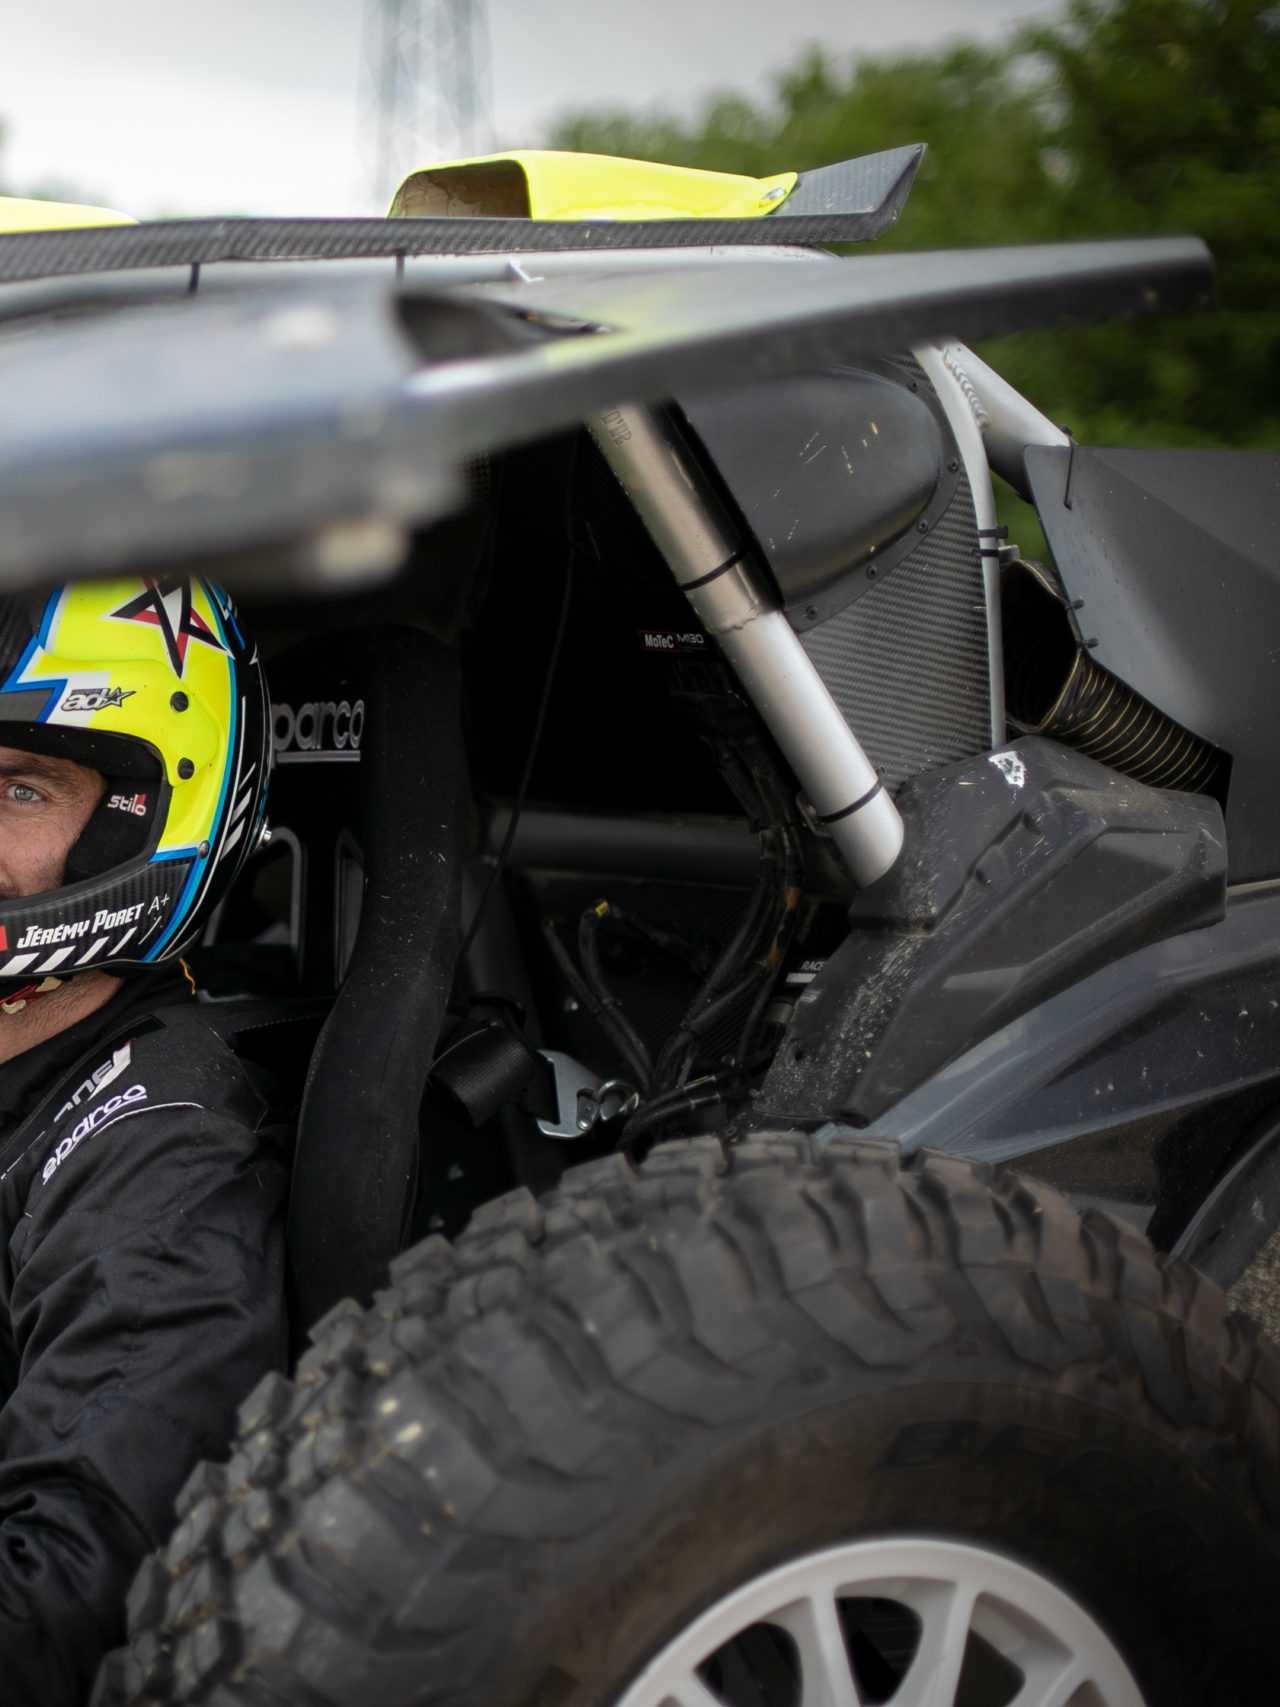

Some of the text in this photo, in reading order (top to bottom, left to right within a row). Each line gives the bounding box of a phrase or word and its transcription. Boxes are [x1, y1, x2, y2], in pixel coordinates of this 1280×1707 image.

[644, 633, 675, 649] MoTeC
[268, 699, 365, 769] parco
[108, 793, 147, 816] Stilo
[91, 902, 145, 934] PORET
[147, 893, 170, 915] A+
[42, 1084, 148, 1186] sparco
